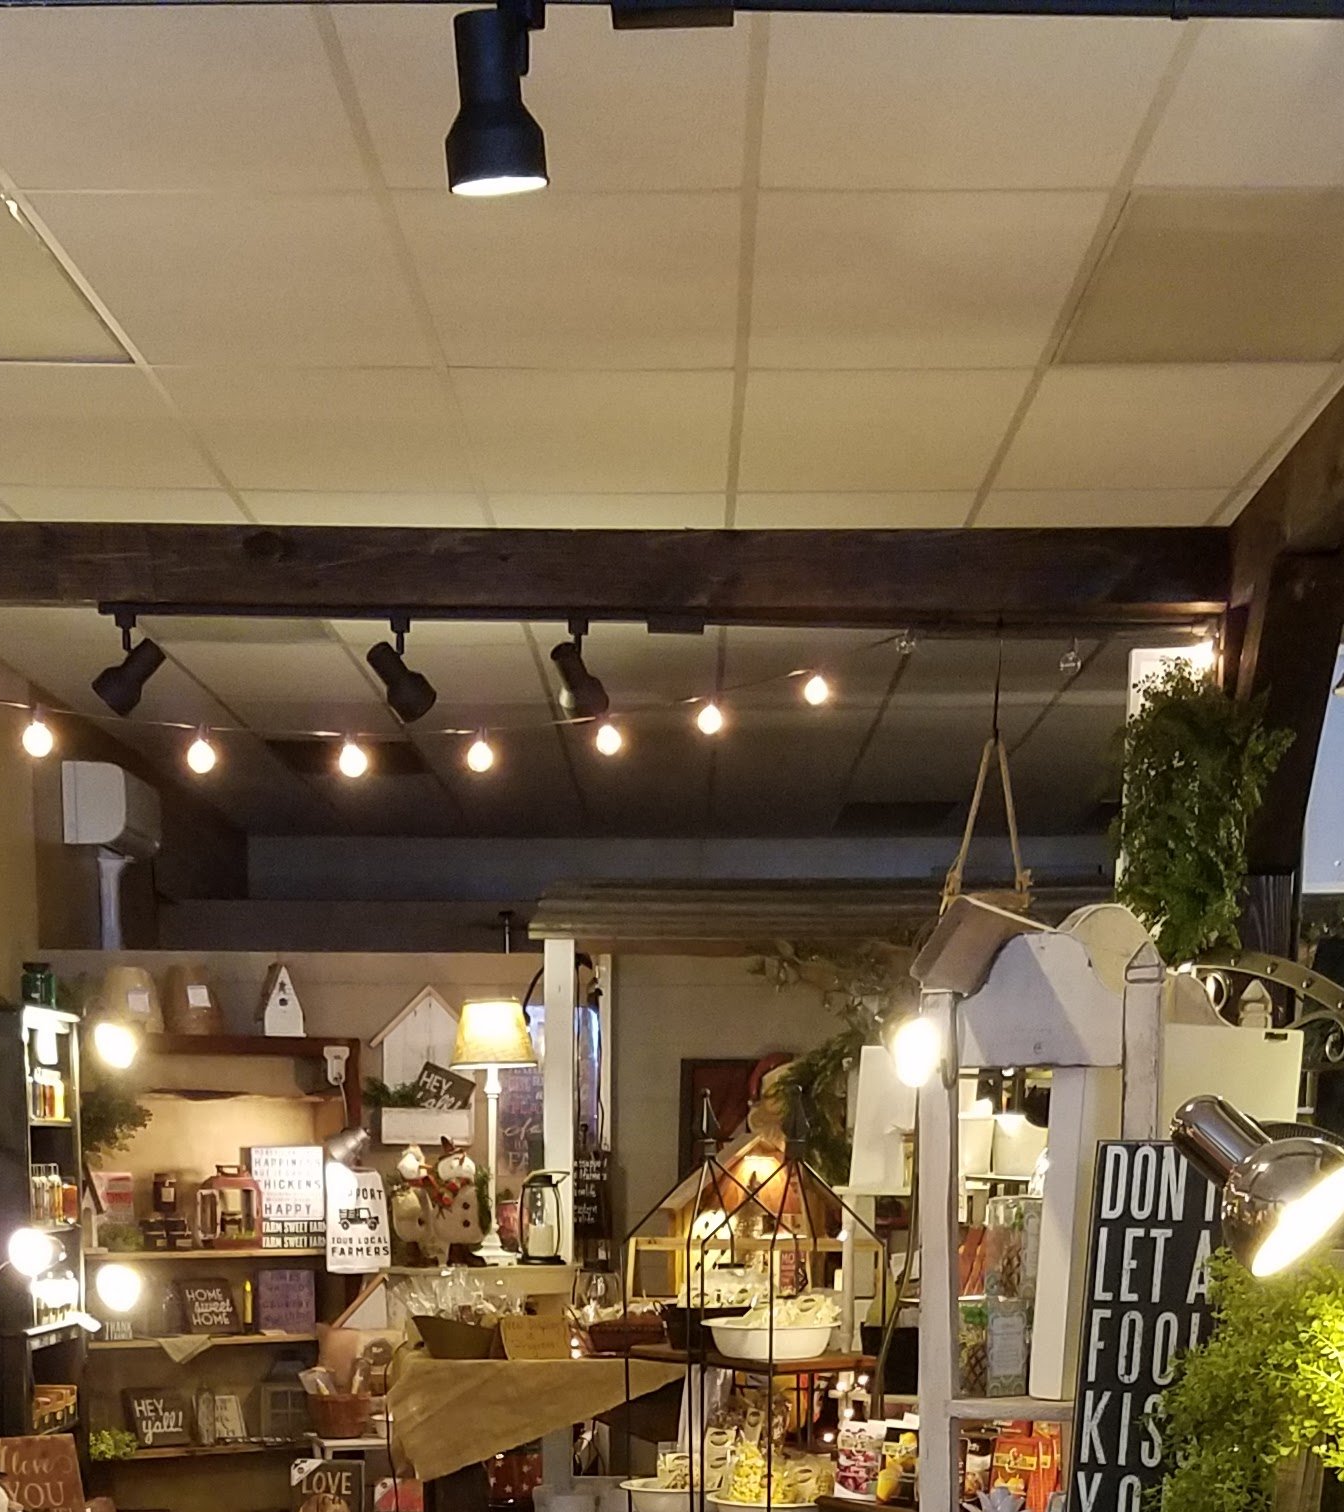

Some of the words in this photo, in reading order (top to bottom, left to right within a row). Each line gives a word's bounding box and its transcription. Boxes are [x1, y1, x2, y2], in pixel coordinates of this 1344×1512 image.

[419, 1070, 453, 1095] HEY
[1101, 1145, 1218, 1222] DON
[264, 1203, 312, 1215] HAPPY
[331, 1246, 390, 1257] FARMERS
[358, 1236, 389, 1245] LOCAL
[1094, 1227, 1173, 1304] LET
[185, 1288, 223, 1301] HOME
[194, 1300, 233, 1312] sweet
[192, 1313, 231, 1325] HOME
[134, 1400, 164, 1417] HEY
[142, 1411, 183, 1445] y'all!
[1079, 1394, 1167, 1468] KIS
[12, 1450, 55, 1475] love
[6, 1480, 65, 1508] YOU
[302, 1471, 353, 1494] LOVE
